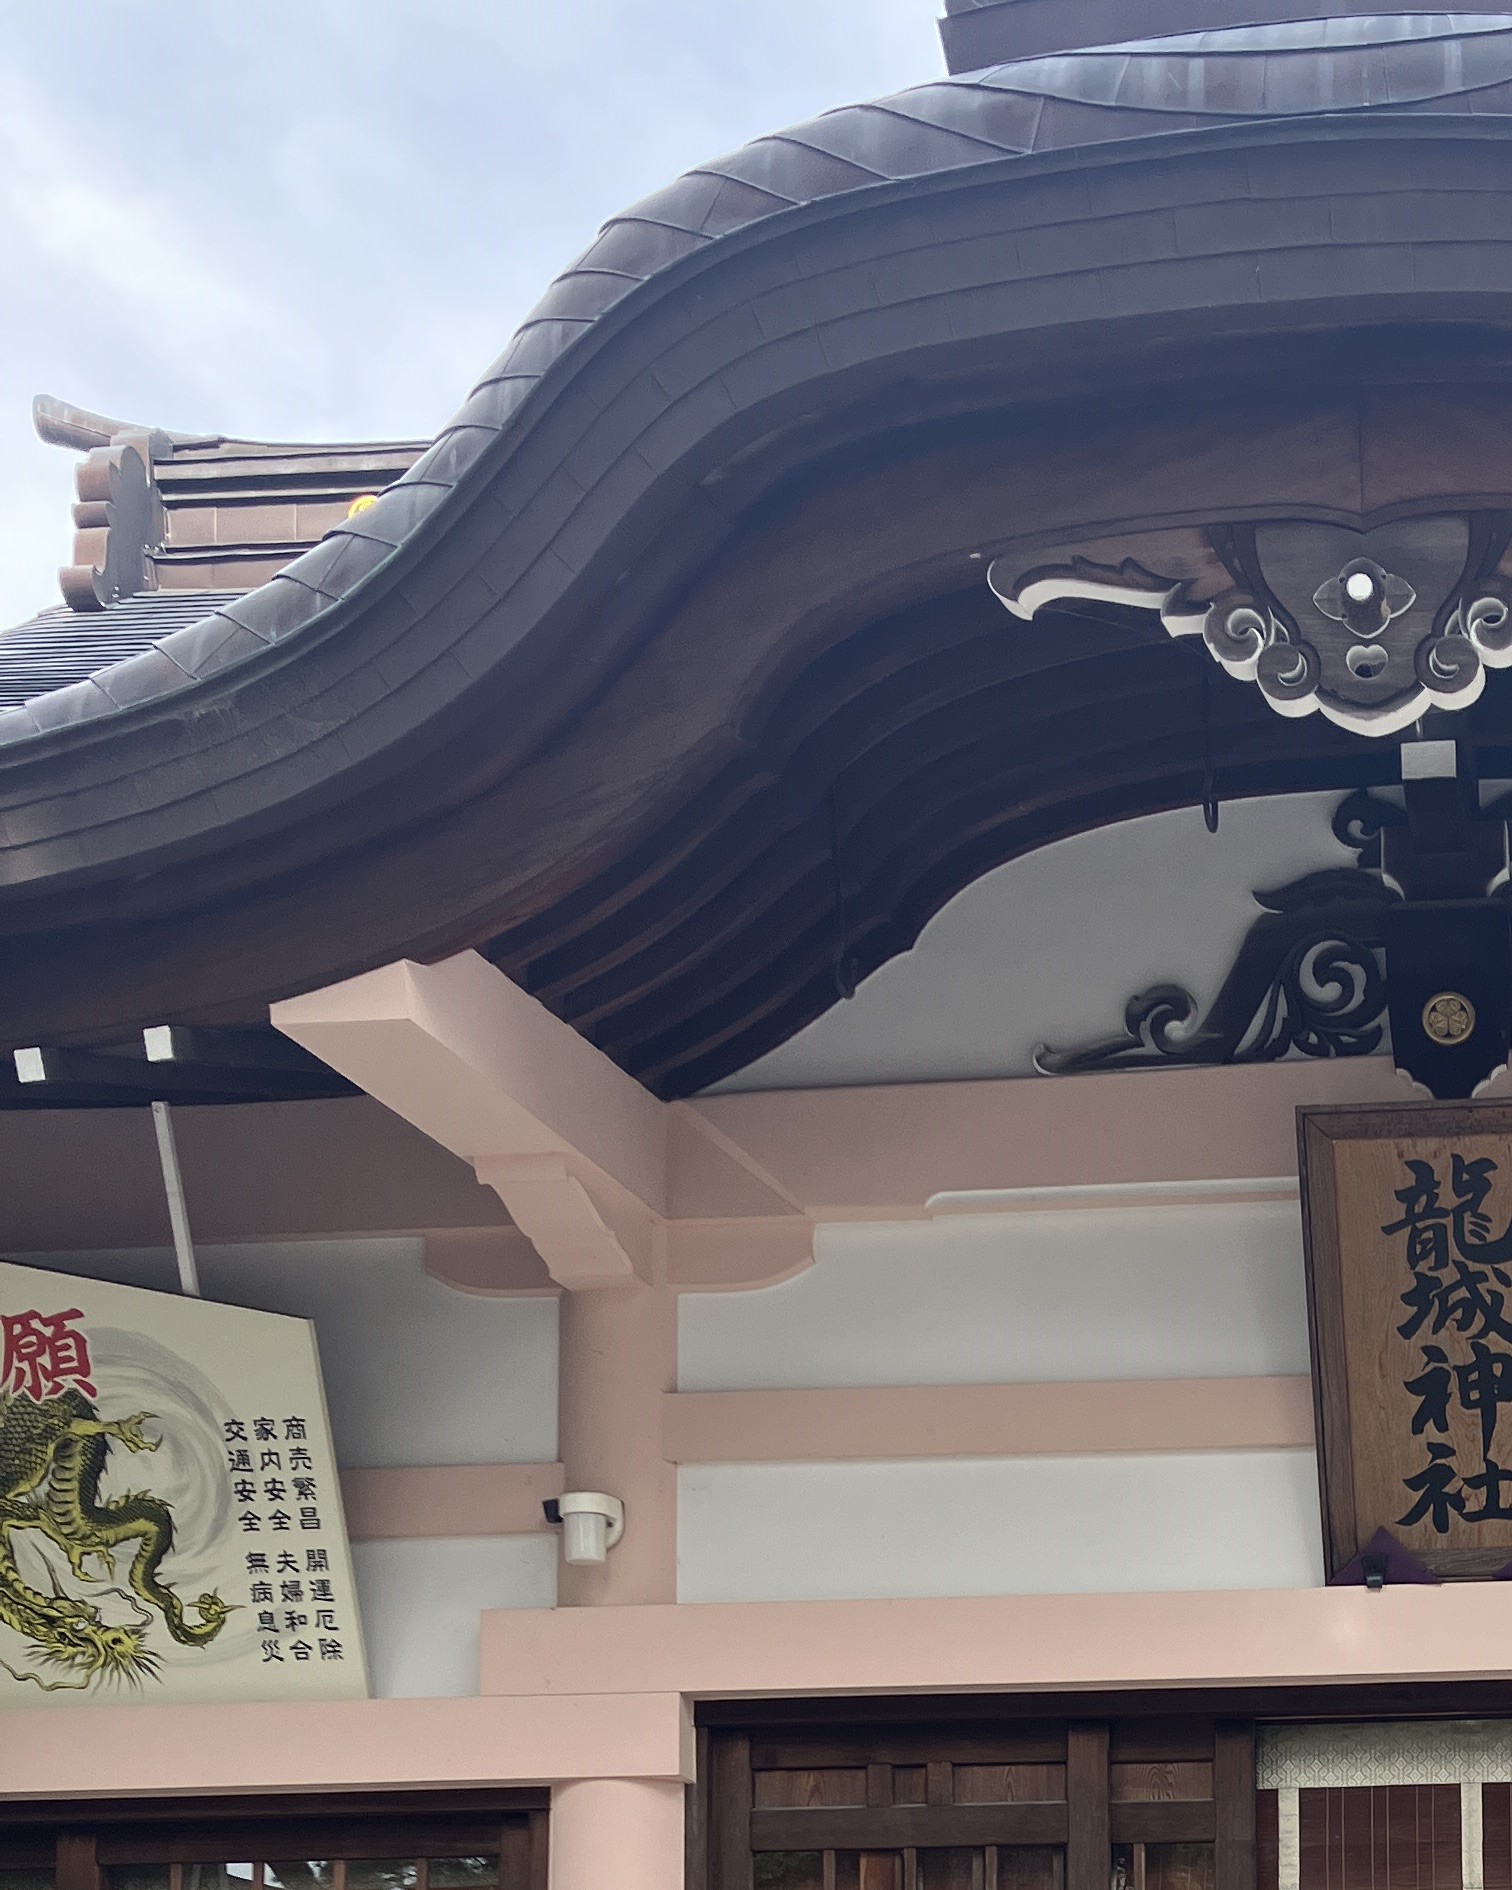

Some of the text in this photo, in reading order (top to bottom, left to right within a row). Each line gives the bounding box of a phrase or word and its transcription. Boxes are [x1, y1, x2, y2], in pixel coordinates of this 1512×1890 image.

[0, 1308, 97, 1399] 願
[224, 1418, 285, 1662] 交通安全 無病息災
[253, 1416, 313, 1661] 家内安全 夫婦和合
[282, 1415, 344, 1661] 商売繁昌 開運厄除
